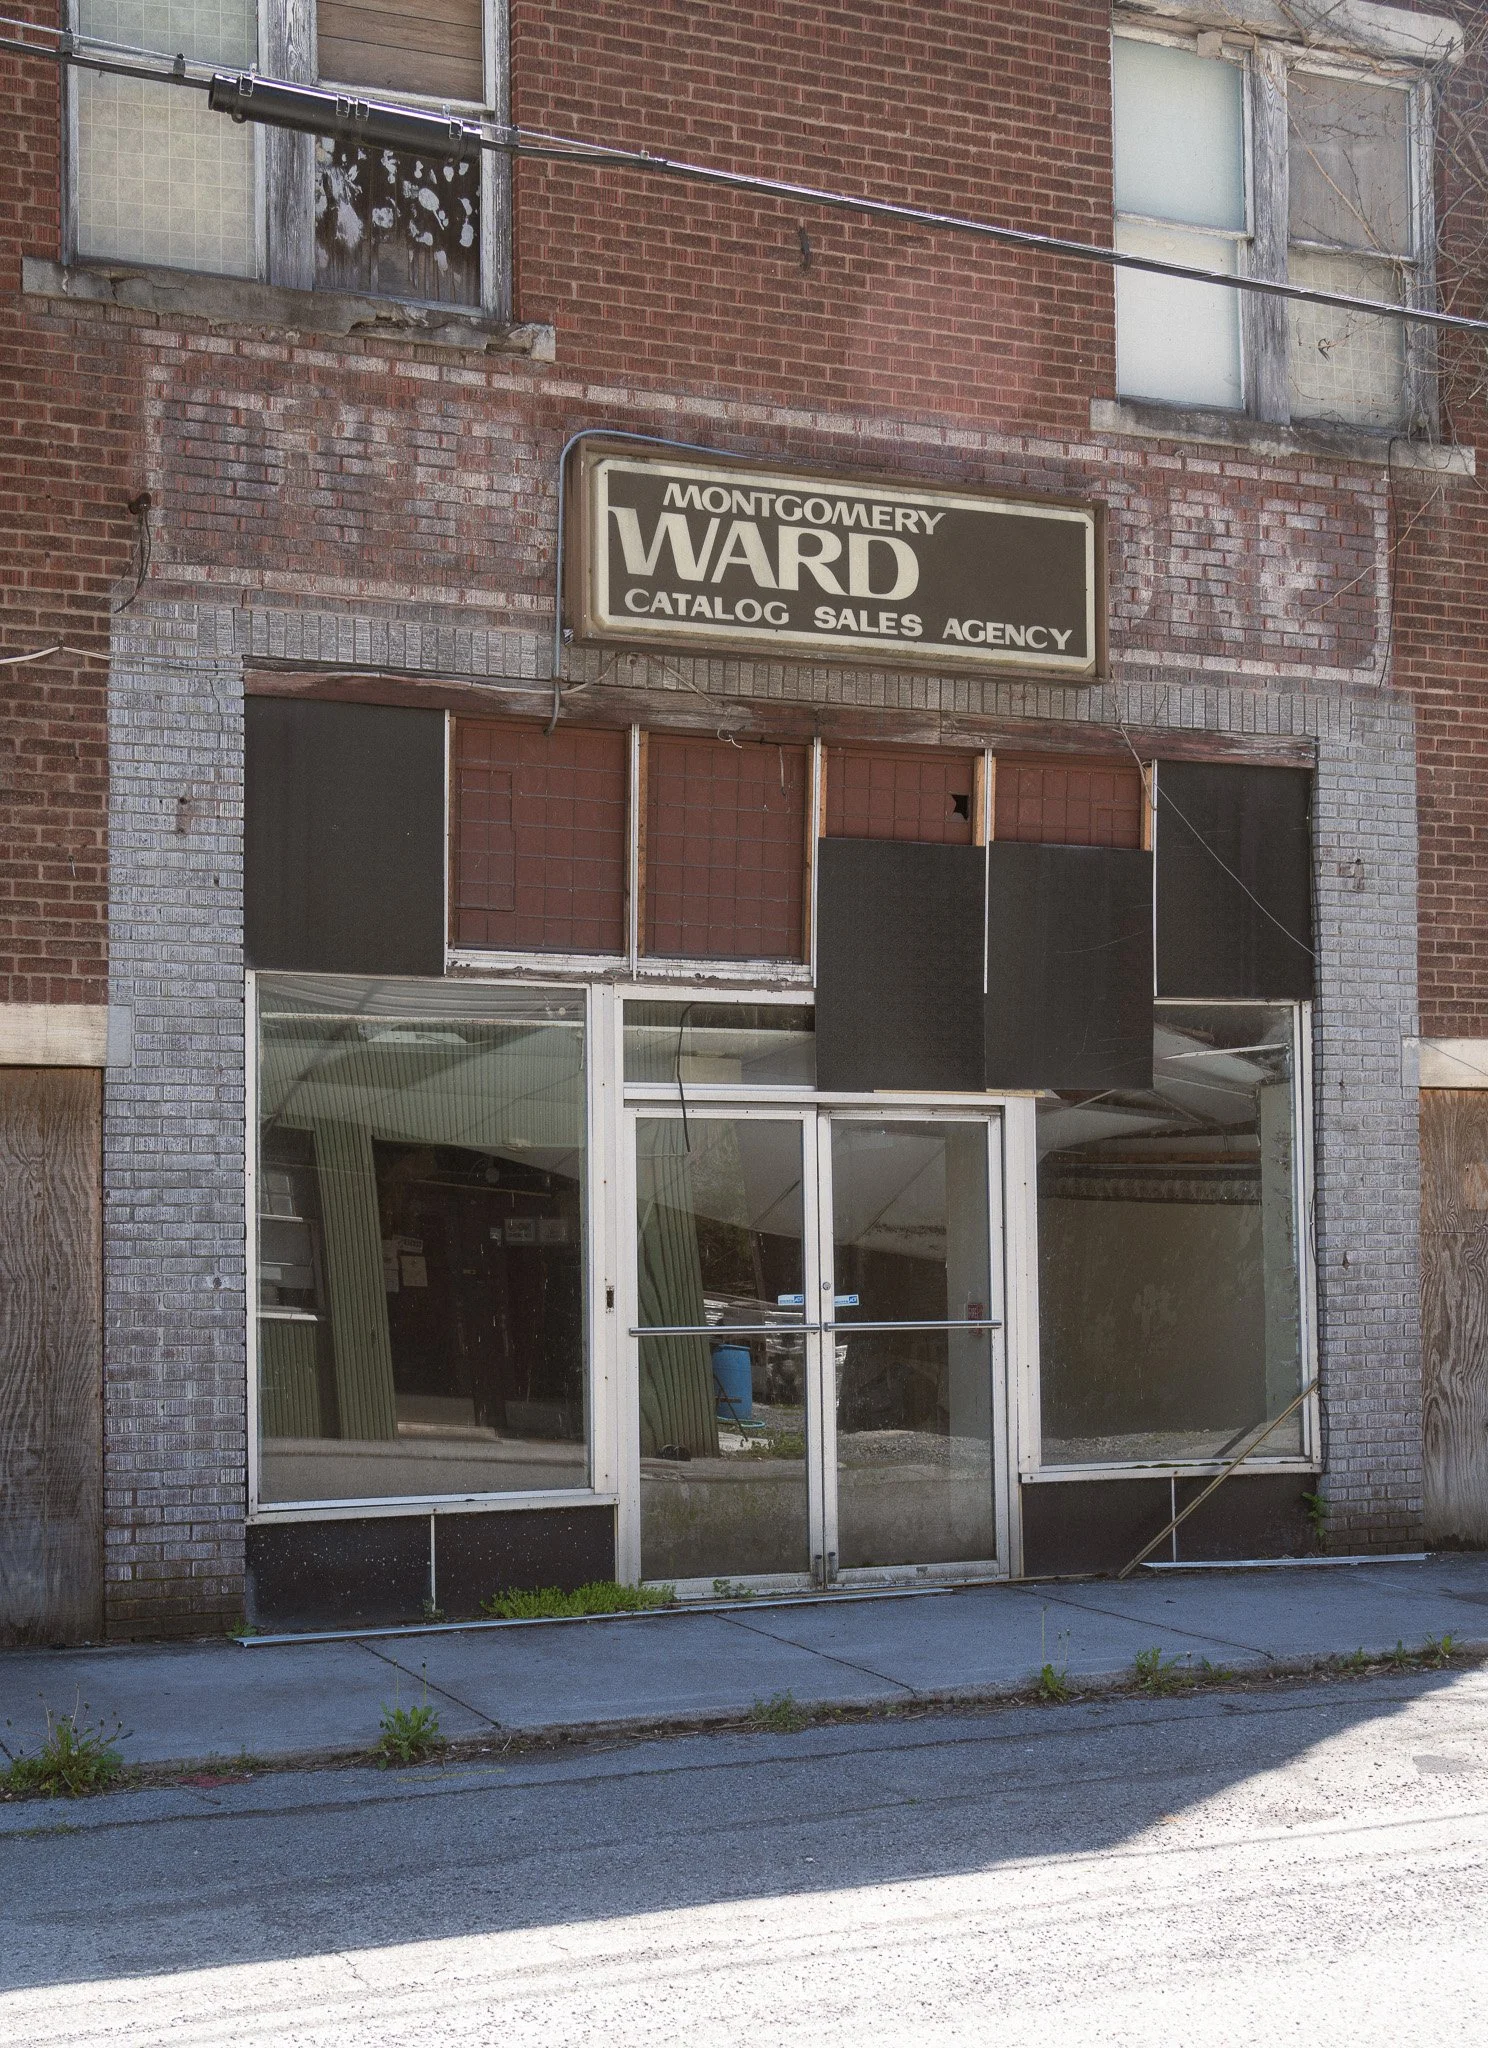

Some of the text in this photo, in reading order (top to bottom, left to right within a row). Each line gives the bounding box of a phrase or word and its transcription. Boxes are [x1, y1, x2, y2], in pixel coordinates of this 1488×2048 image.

[663, 483, 945, 535] MONTGOMERY
[609, 506, 920, 600] WARD
[625, 589, 1072, 650] CATALOG SALES AGENCY
